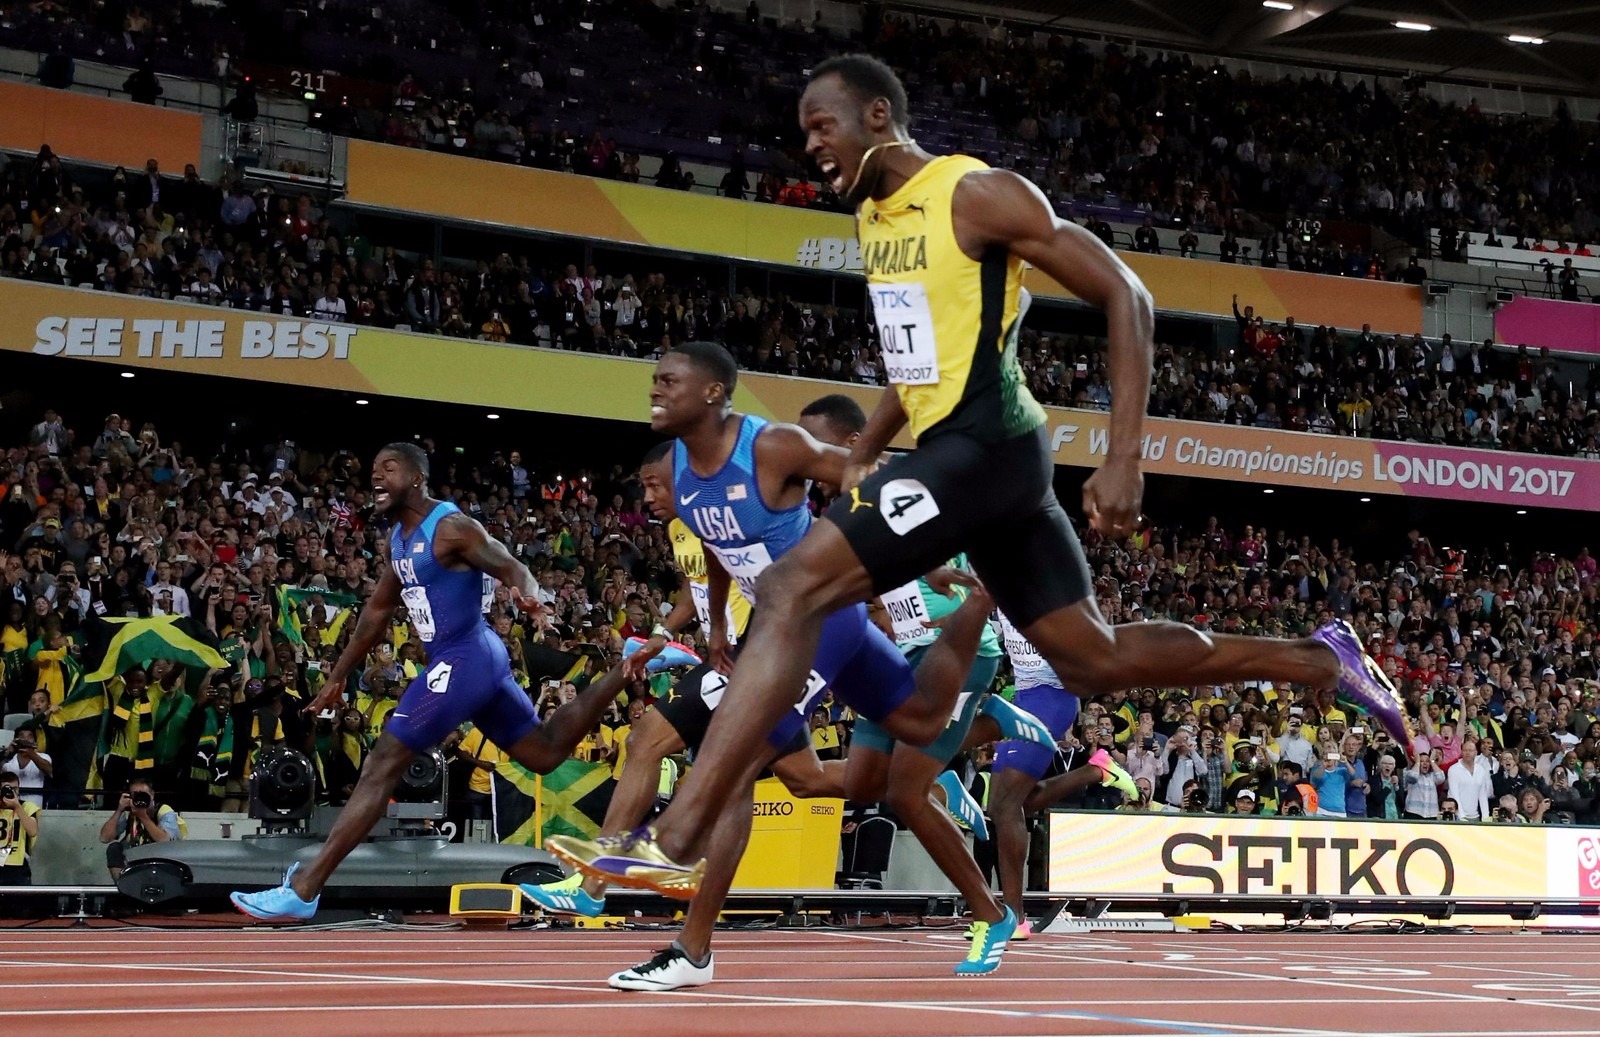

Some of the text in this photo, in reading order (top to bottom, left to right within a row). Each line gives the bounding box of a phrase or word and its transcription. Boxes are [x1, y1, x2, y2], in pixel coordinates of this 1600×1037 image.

[290, 70, 326, 92] 211
[878, 290, 911, 308] TDK
[32, 316, 357, 359] SEE THE BEST
[882, 324, 916, 354] OLT
[905, 366, 932, 380] 2017
[1089, 428, 1167, 461] Wld
[1175, 437, 1364, 484] Championships
[1373, 454, 1504, 491] LONDON
[1508, 466, 1575, 496] 2017
[888, 493, 924, 519] 4
[692, 505, 746, 541] USA
[391, 557, 419, 585] USA
[887, 595, 923, 623] MBINE
[702, 676, 727, 696] 7
[752, 802, 794, 816] EIKO
[811, 806, 835, 815] SEIKO
[1161, 833, 1455, 896] SEIKO
